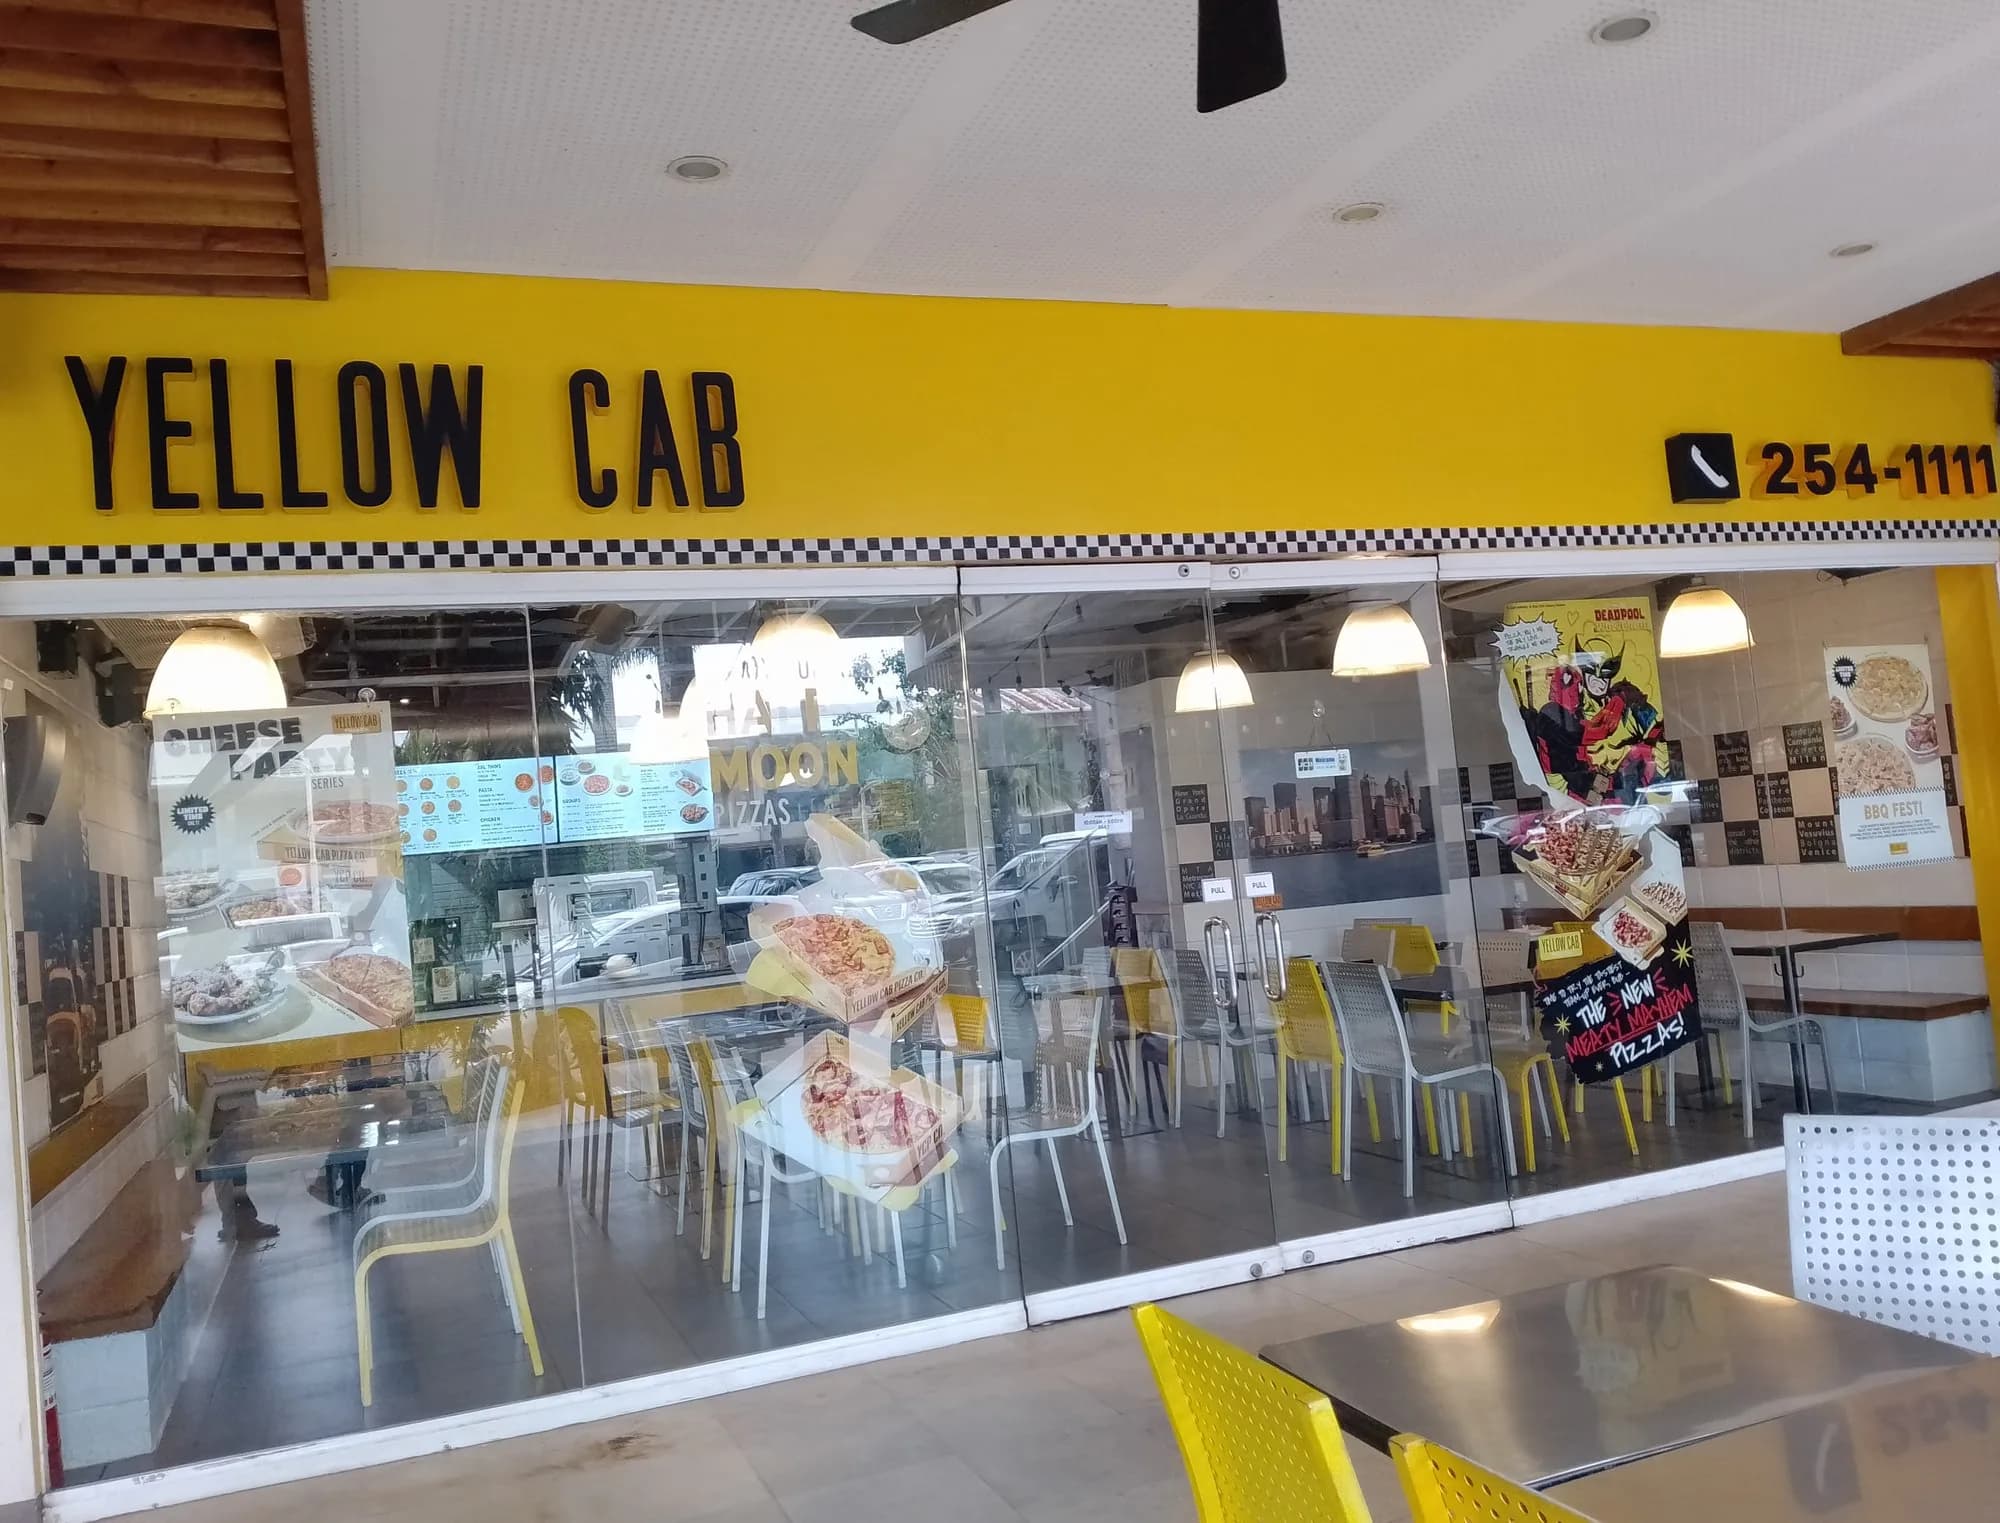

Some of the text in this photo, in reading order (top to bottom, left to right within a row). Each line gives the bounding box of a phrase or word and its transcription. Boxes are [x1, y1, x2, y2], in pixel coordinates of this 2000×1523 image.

[64, 356, 747, 511] YELLOW CAB
[1761, 442, 1997, 495] 254-1111
[1594, 608, 1645, 621] DEADPOOL
[164, 717, 303, 758] CHEESE
[709, 741, 859, 793] MOON
[1790, 755, 1826, 764] Milan
[312, 776, 344, 790] SERIES
[714, 798, 791, 829] PIZZAS
[1798, 820, 1834, 828] Mount
[1864, 803, 1888, 820] BBQ
[1800, 829, 1835, 837] Vesuvius
[1801, 848, 1837, 856] Venice
[1542, 934, 1580, 953] YELLOW CAB
[852, 992, 879, 1013] YELLOW
[880, 987, 893, 998] CAB
[894, 975, 913, 991] PIZZA
[1567, 981, 1582, 994] TRY
[1576, 974, 1655, 1028] THE NEW
[1565, 983, 1694, 1063] MEATY MAYHEM
[1609, 1011, 1687, 1068] PIZZAS!
